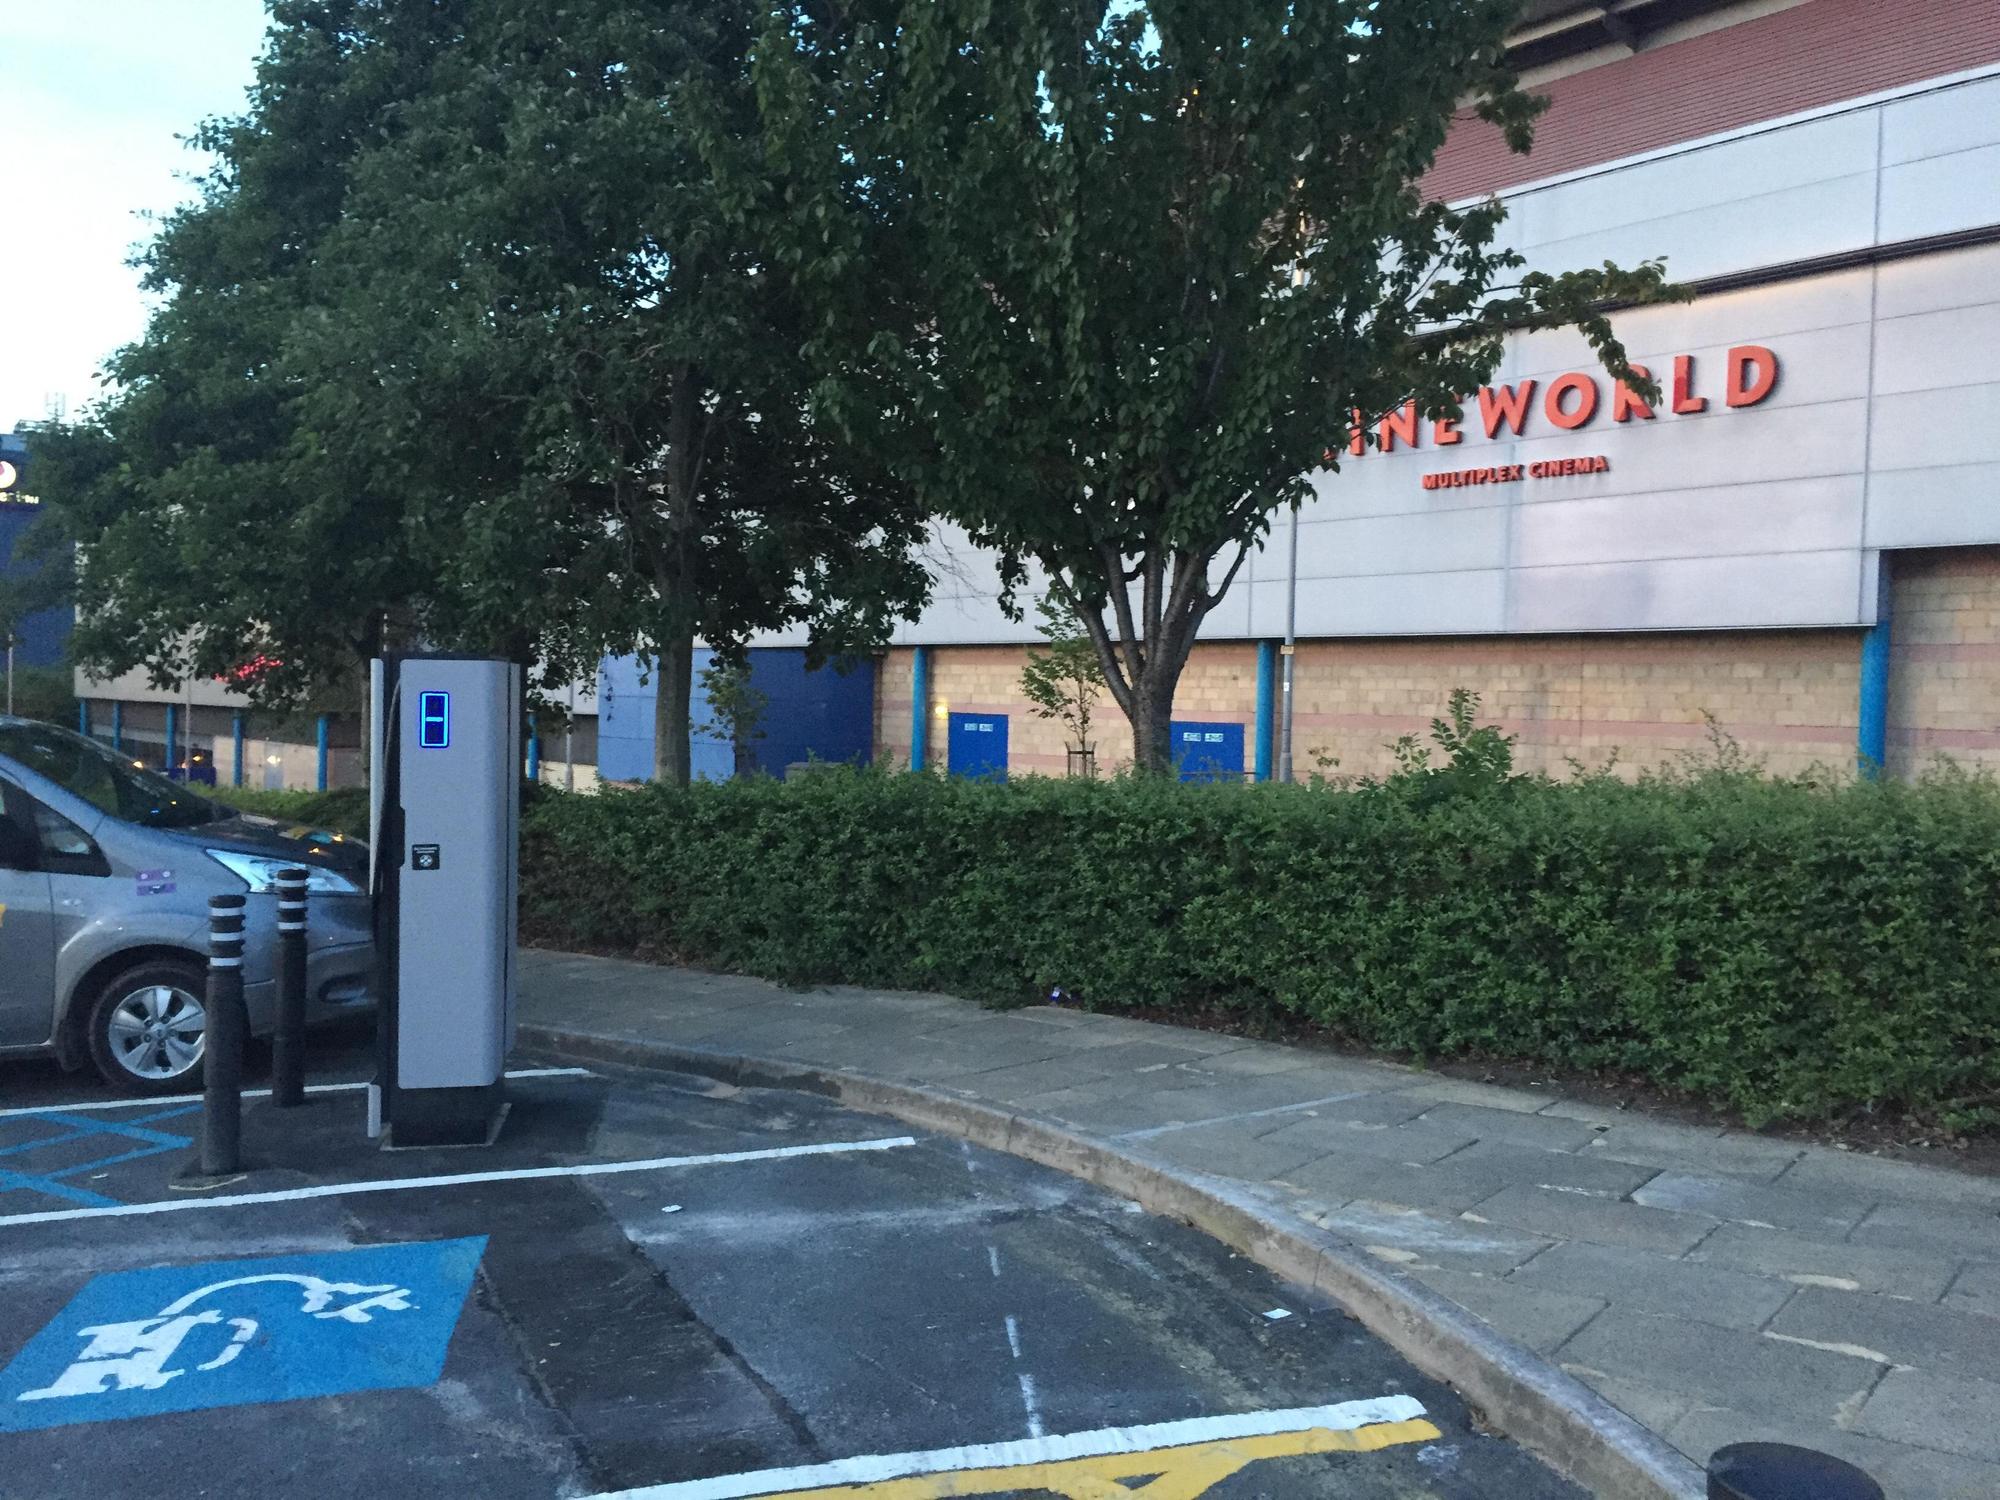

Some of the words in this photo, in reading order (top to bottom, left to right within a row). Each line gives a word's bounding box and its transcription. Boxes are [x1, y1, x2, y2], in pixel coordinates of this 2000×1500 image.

[1322, 344, 1779, 460] INEWORLD
[1422, 464, 1523, 490] MULTIPLEX
[1528, 455, 1610, 479] CINEMA
